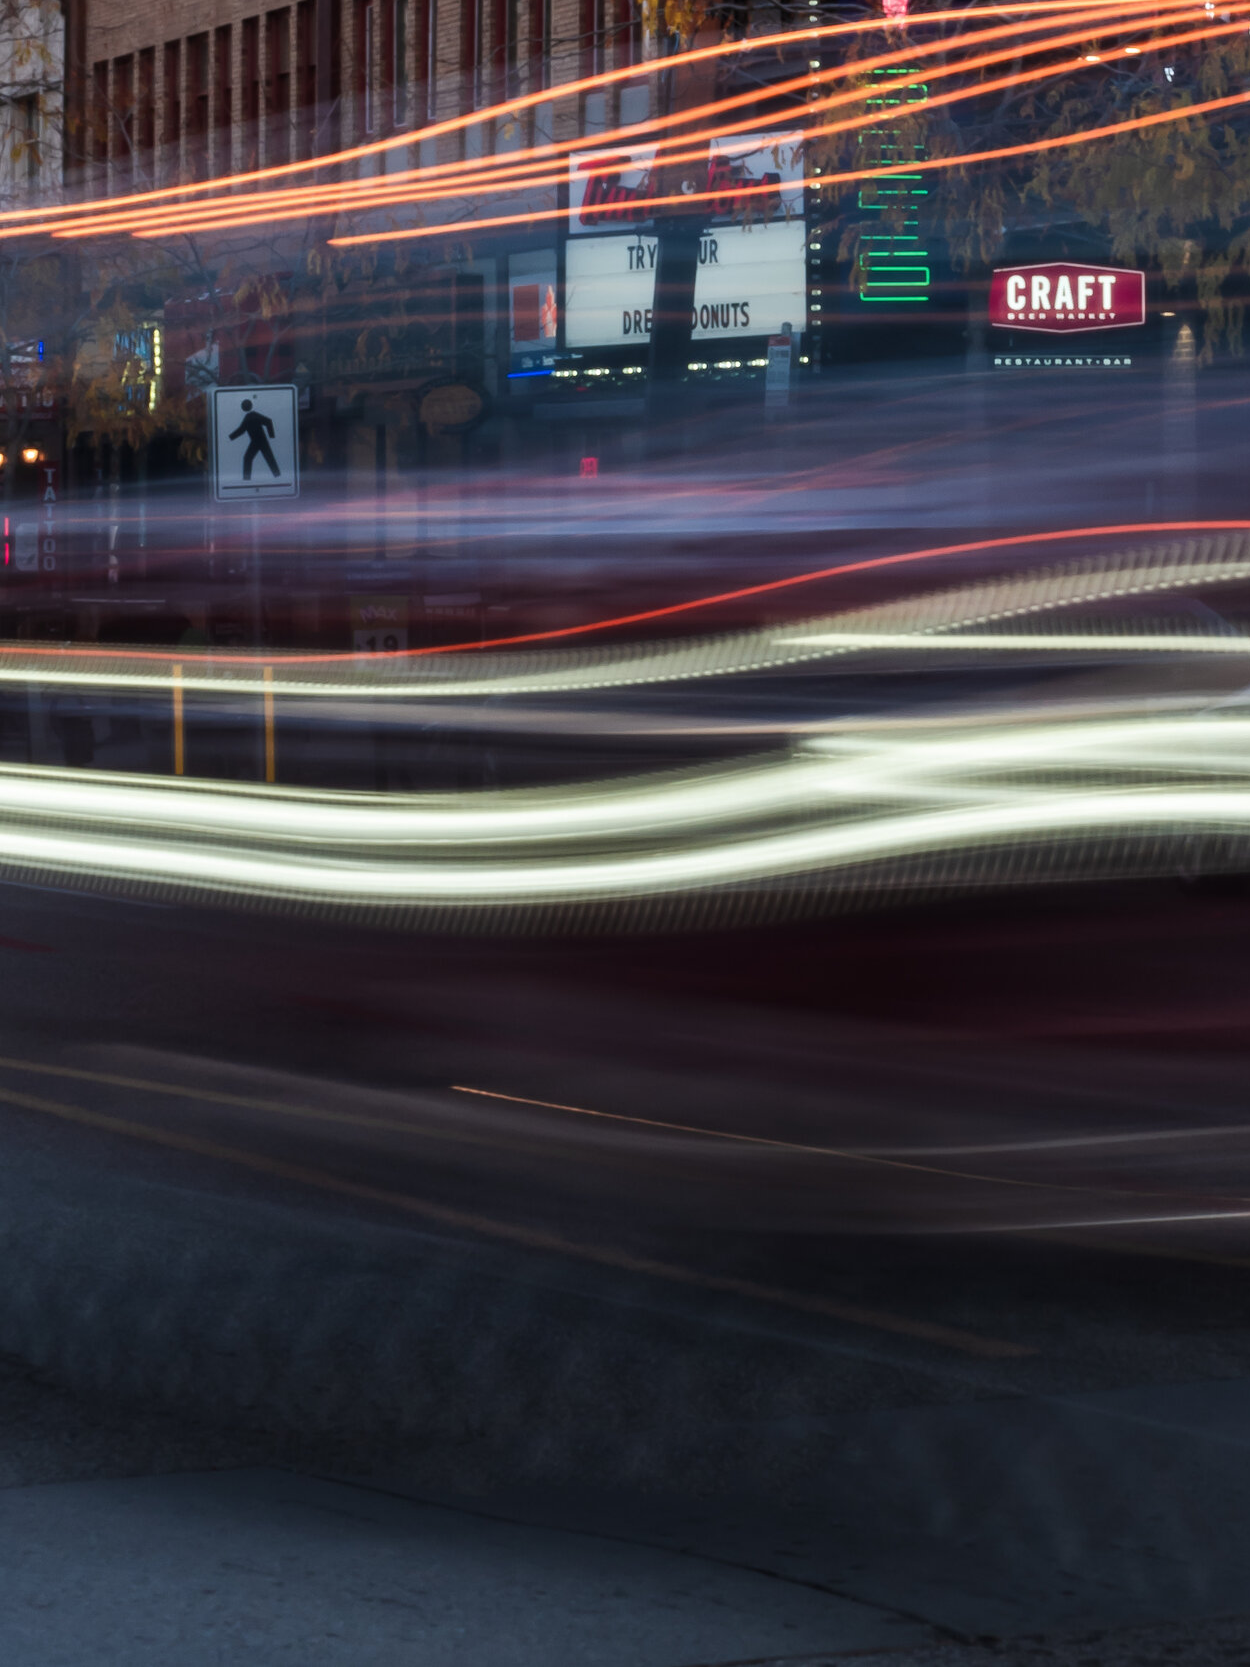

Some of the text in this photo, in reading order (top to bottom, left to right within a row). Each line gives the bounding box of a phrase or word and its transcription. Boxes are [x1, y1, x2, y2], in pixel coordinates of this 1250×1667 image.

[627, 245, 658, 271] TRY
[1006, 275, 1117, 310] CRAFT
[994, 358, 1132, 366] RESTAURANT BAR
[43, 467, 57, 572] TATTOO
